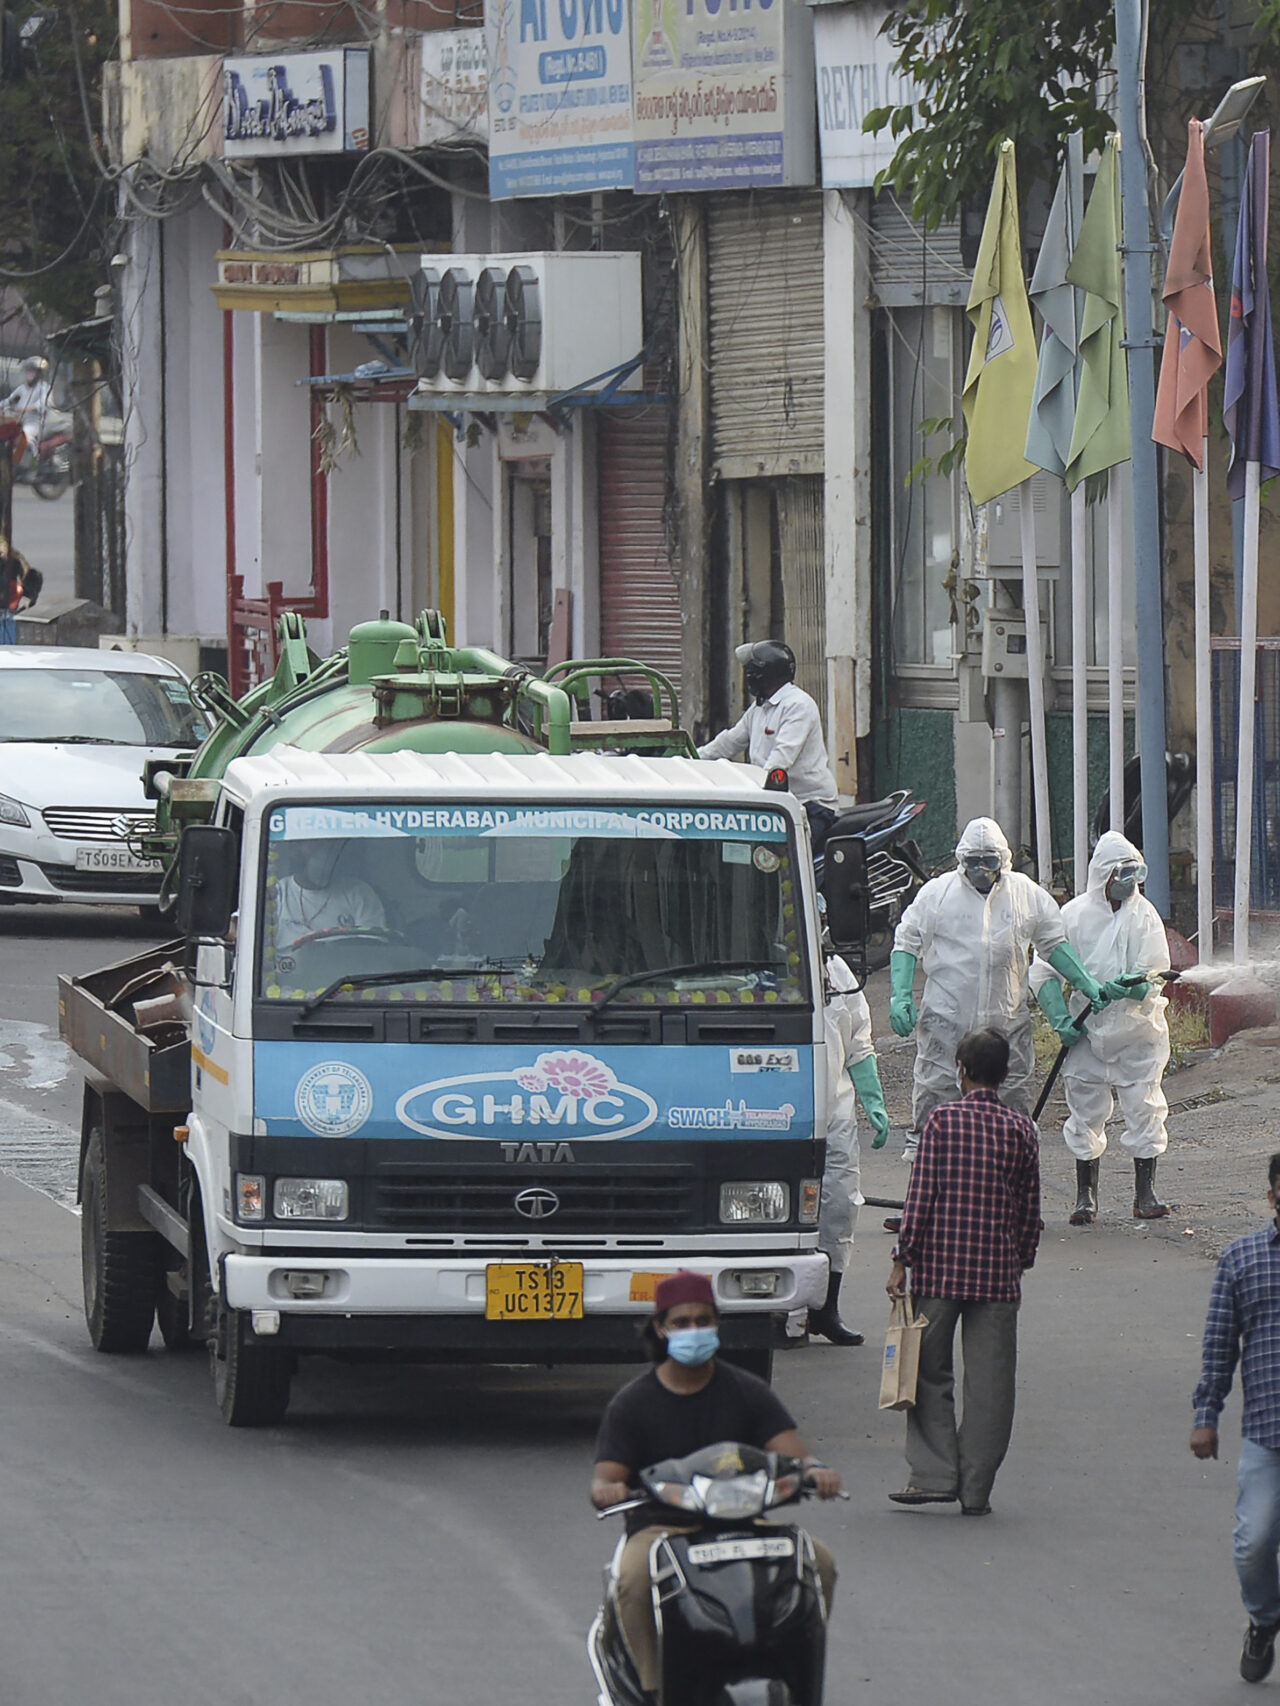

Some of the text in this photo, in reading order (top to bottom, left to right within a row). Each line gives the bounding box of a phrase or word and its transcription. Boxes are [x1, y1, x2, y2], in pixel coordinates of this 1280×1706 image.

[820, 63, 880, 131] REKHA
[269, 809, 787, 833] GEATER HYDERABAD MUNICIPAL CORPORATION
[432, 1094, 625, 1126] GHMC
[500, 1142, 576, 1163] TATA
[515, 1270, 565, 1290] TS13
[504, 1291, 579, 1313] UC1377
